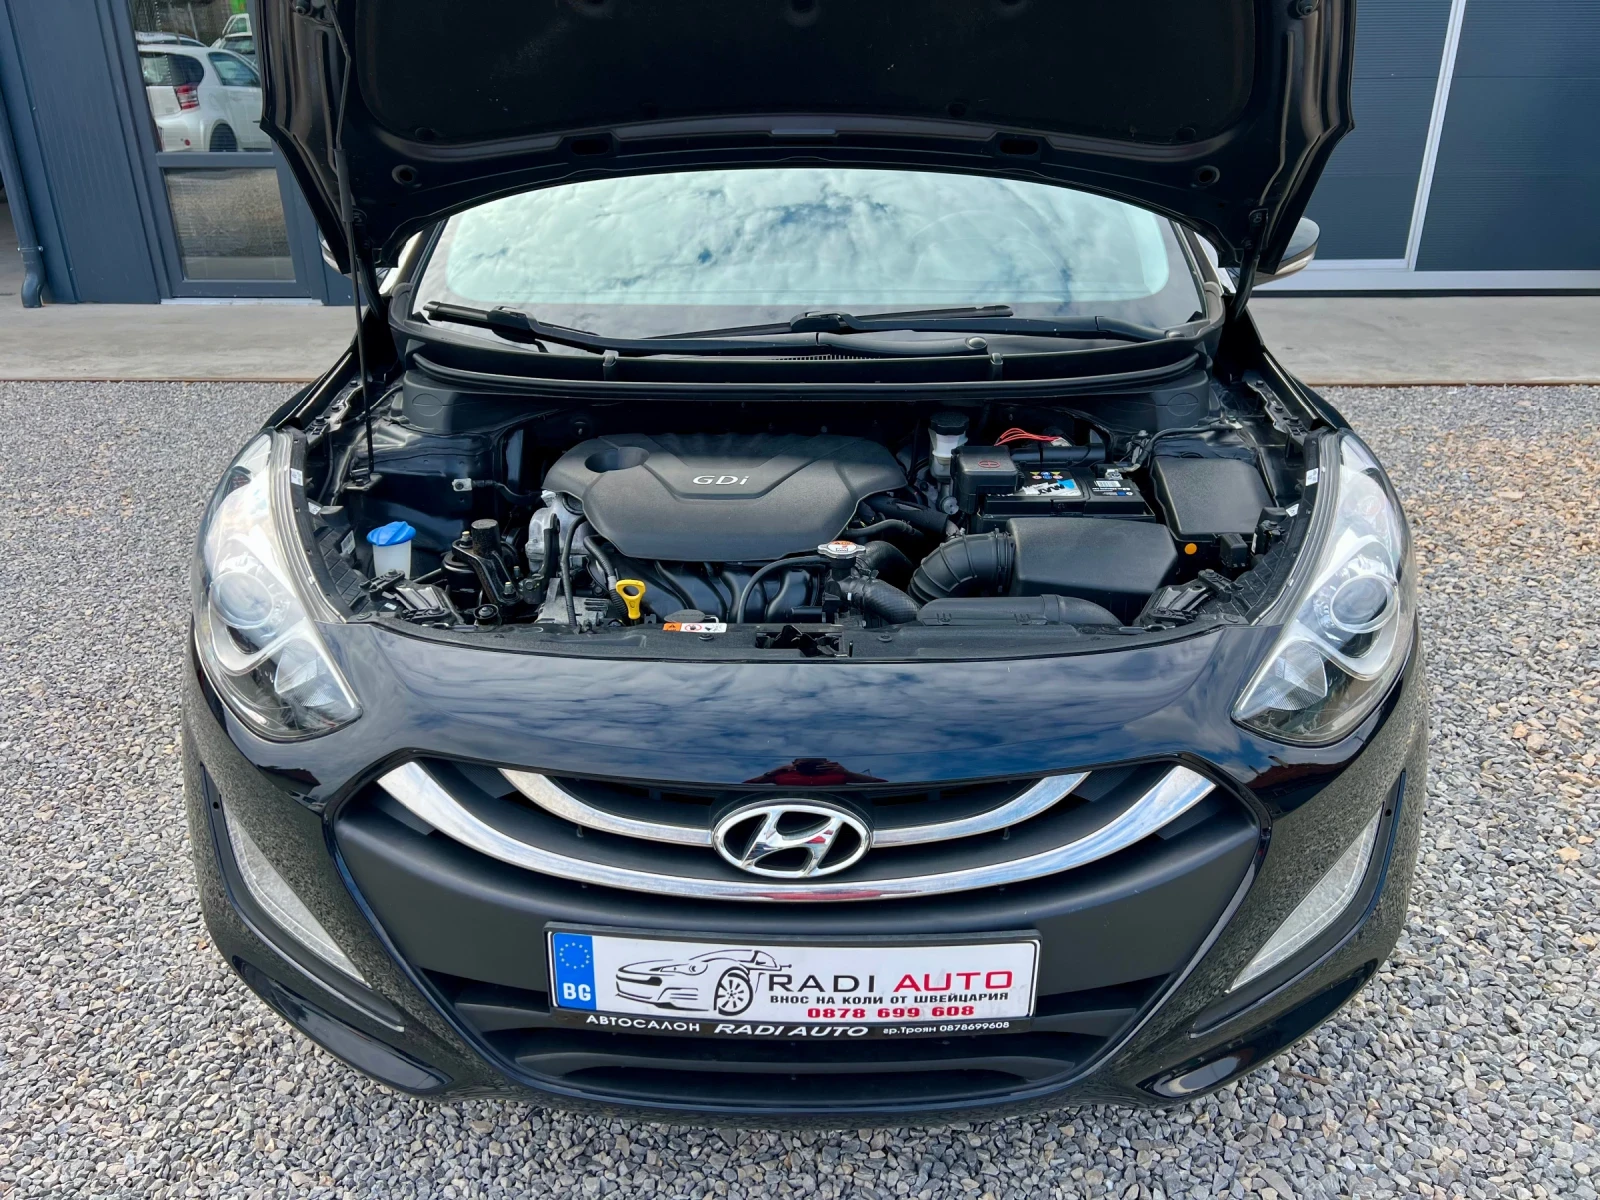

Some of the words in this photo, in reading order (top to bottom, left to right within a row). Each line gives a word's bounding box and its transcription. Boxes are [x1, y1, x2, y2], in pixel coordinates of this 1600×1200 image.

[692, 475, 750, 486] GDi
[768, 973, 875, 993] RADI
[893, 970, 1013, 993] AUTO
[562, 982, 592, 1002] BG
[769, 995, 810, 1005] ВНОС
[816, 995, 836, 1005] НА
[842, 996, 884, 1005] КОЛИ
[890, 995, 908, 1005] ОТ
[914, 992, 1009, 1004] ШВЕЙЦАРИЯ
[807, 1007, 866, 1019] 0878
[877, 1007, 920, 1019] 699
[931, 1005, 975, 1018] 608
[585, 1014, 701, 1032] АВТОСАЛОН
[713, 1023, 785, 1036] RADI
[787, 1026, 869, 1037] AUTO
[939, 1021, 1010, 1032] 0878699608
